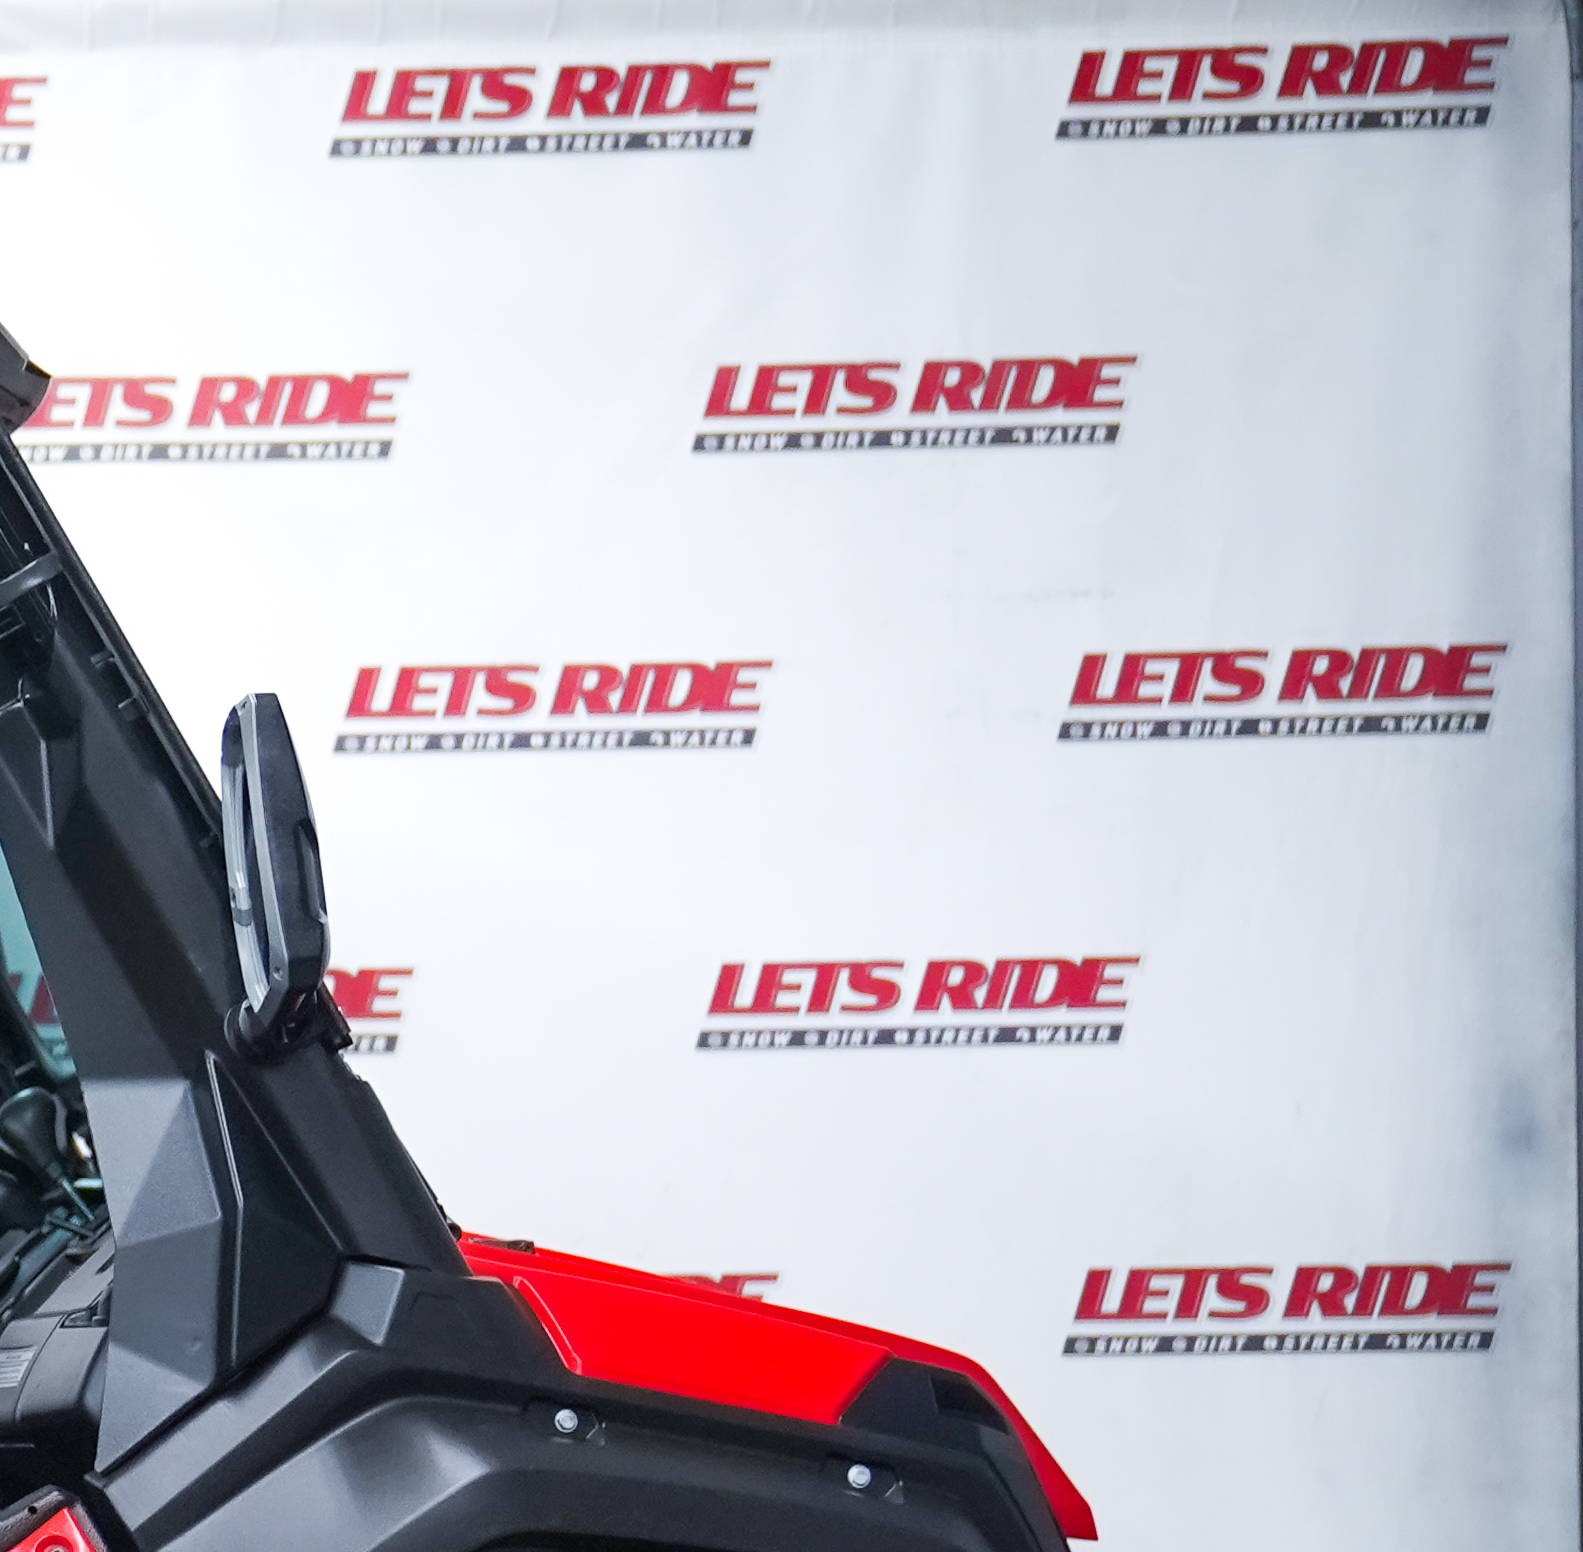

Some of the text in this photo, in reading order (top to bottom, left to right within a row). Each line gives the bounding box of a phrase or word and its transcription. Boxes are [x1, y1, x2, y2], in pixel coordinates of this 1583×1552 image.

[341, 60, 770, 122] LETS RIDE
[1068, 36, 1509, 104] LETS RIDE
[358, 130, 742, 155] SNOW DIRT STREET WATER
[1088, 109, 1477, 137] SNOW DIRT STREET WATER
[19, 372, 409, 428] ETS RIDE
[704, 355, 1137, 418] LETS RIDE
[723, 426, 1107, 450] SNOW DIRT STREET WATER
[345, 660, 773, 719] LETS RIDE
[1069, 644, 1507, 706] LETS RIDE
[364, 729, 744, 753] SNOW DIRT STREET WATER
[1090, 715, 1477, 739] SNOW DIRT STREET WATER
[707, 956, 1141, 1015] LETS RIDE
[728, 1026, 1110, 1048] SNOW DIRT STREET WATER
[1073, 1262, 1513, 1321] LETS RIDE
[1095, 1331, 1481, 1354] SNOW DIRT STREET WATER
